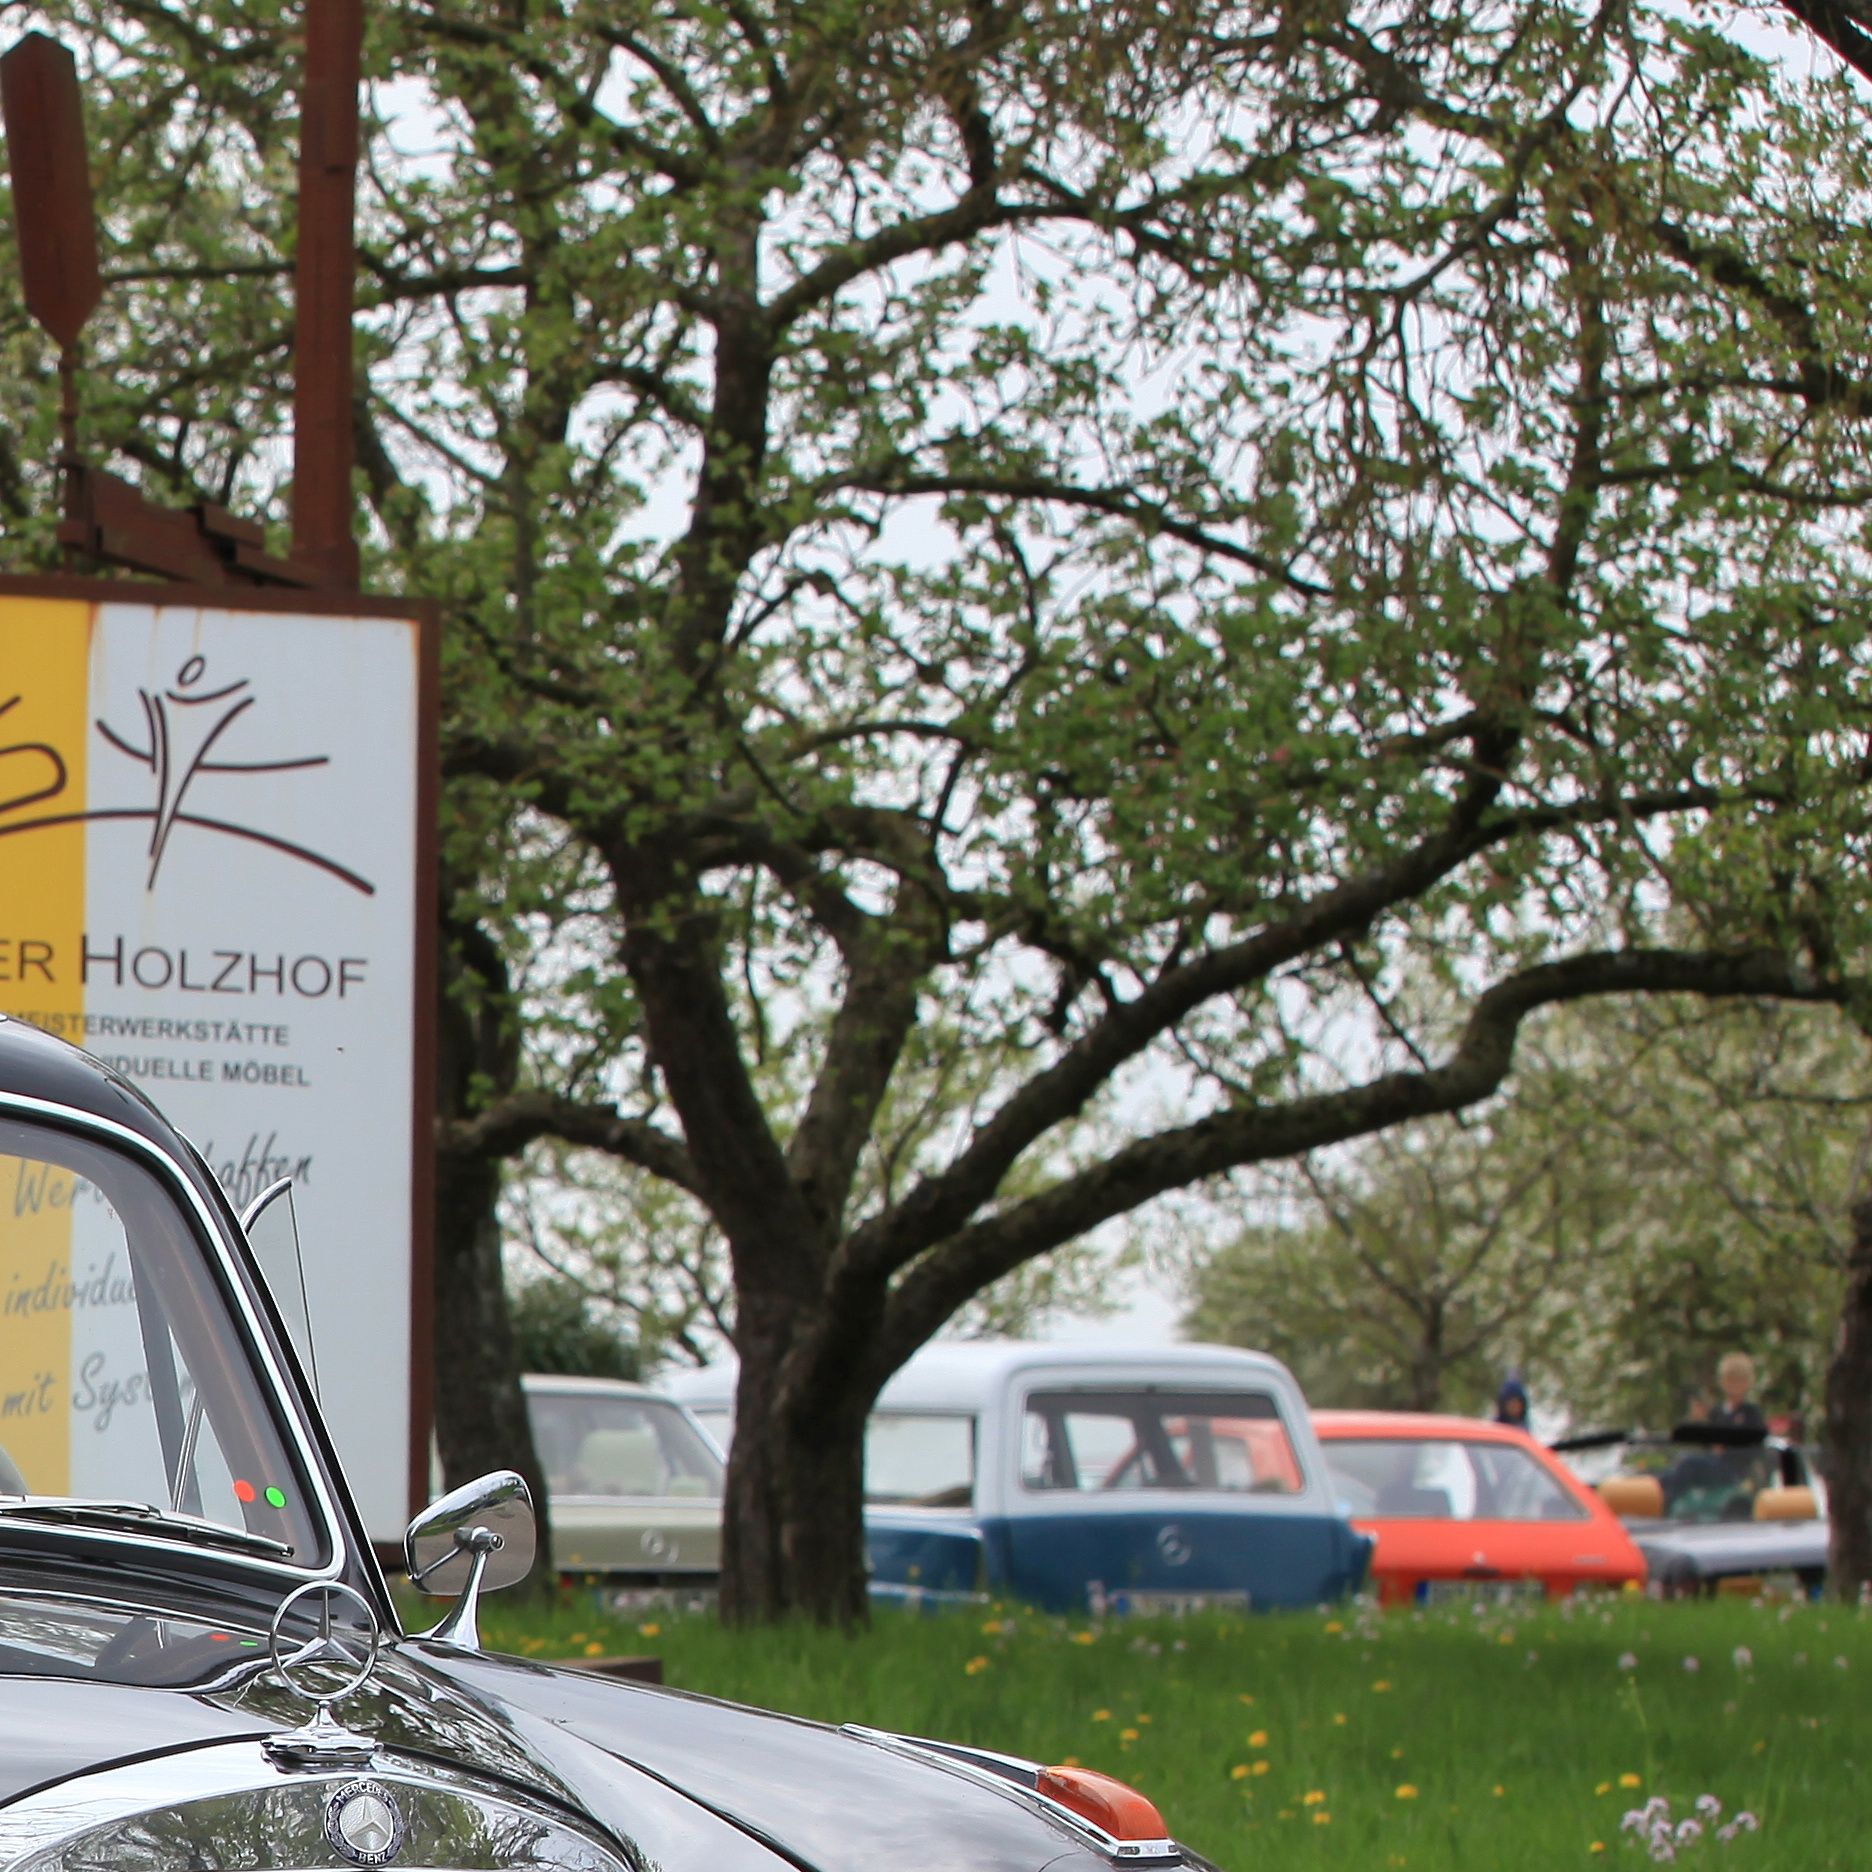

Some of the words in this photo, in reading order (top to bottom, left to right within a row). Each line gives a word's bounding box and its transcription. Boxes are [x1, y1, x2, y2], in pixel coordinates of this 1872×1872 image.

[80, 934, 369, 1000] HOLZHOF
[223, 1060, 311, 1088] MÖBEL
[1, 1371, 56, 1419] mit
[335, 1781, 390, 1805] MERCEDES
[358, 1852, 388, 1864] BENZ
